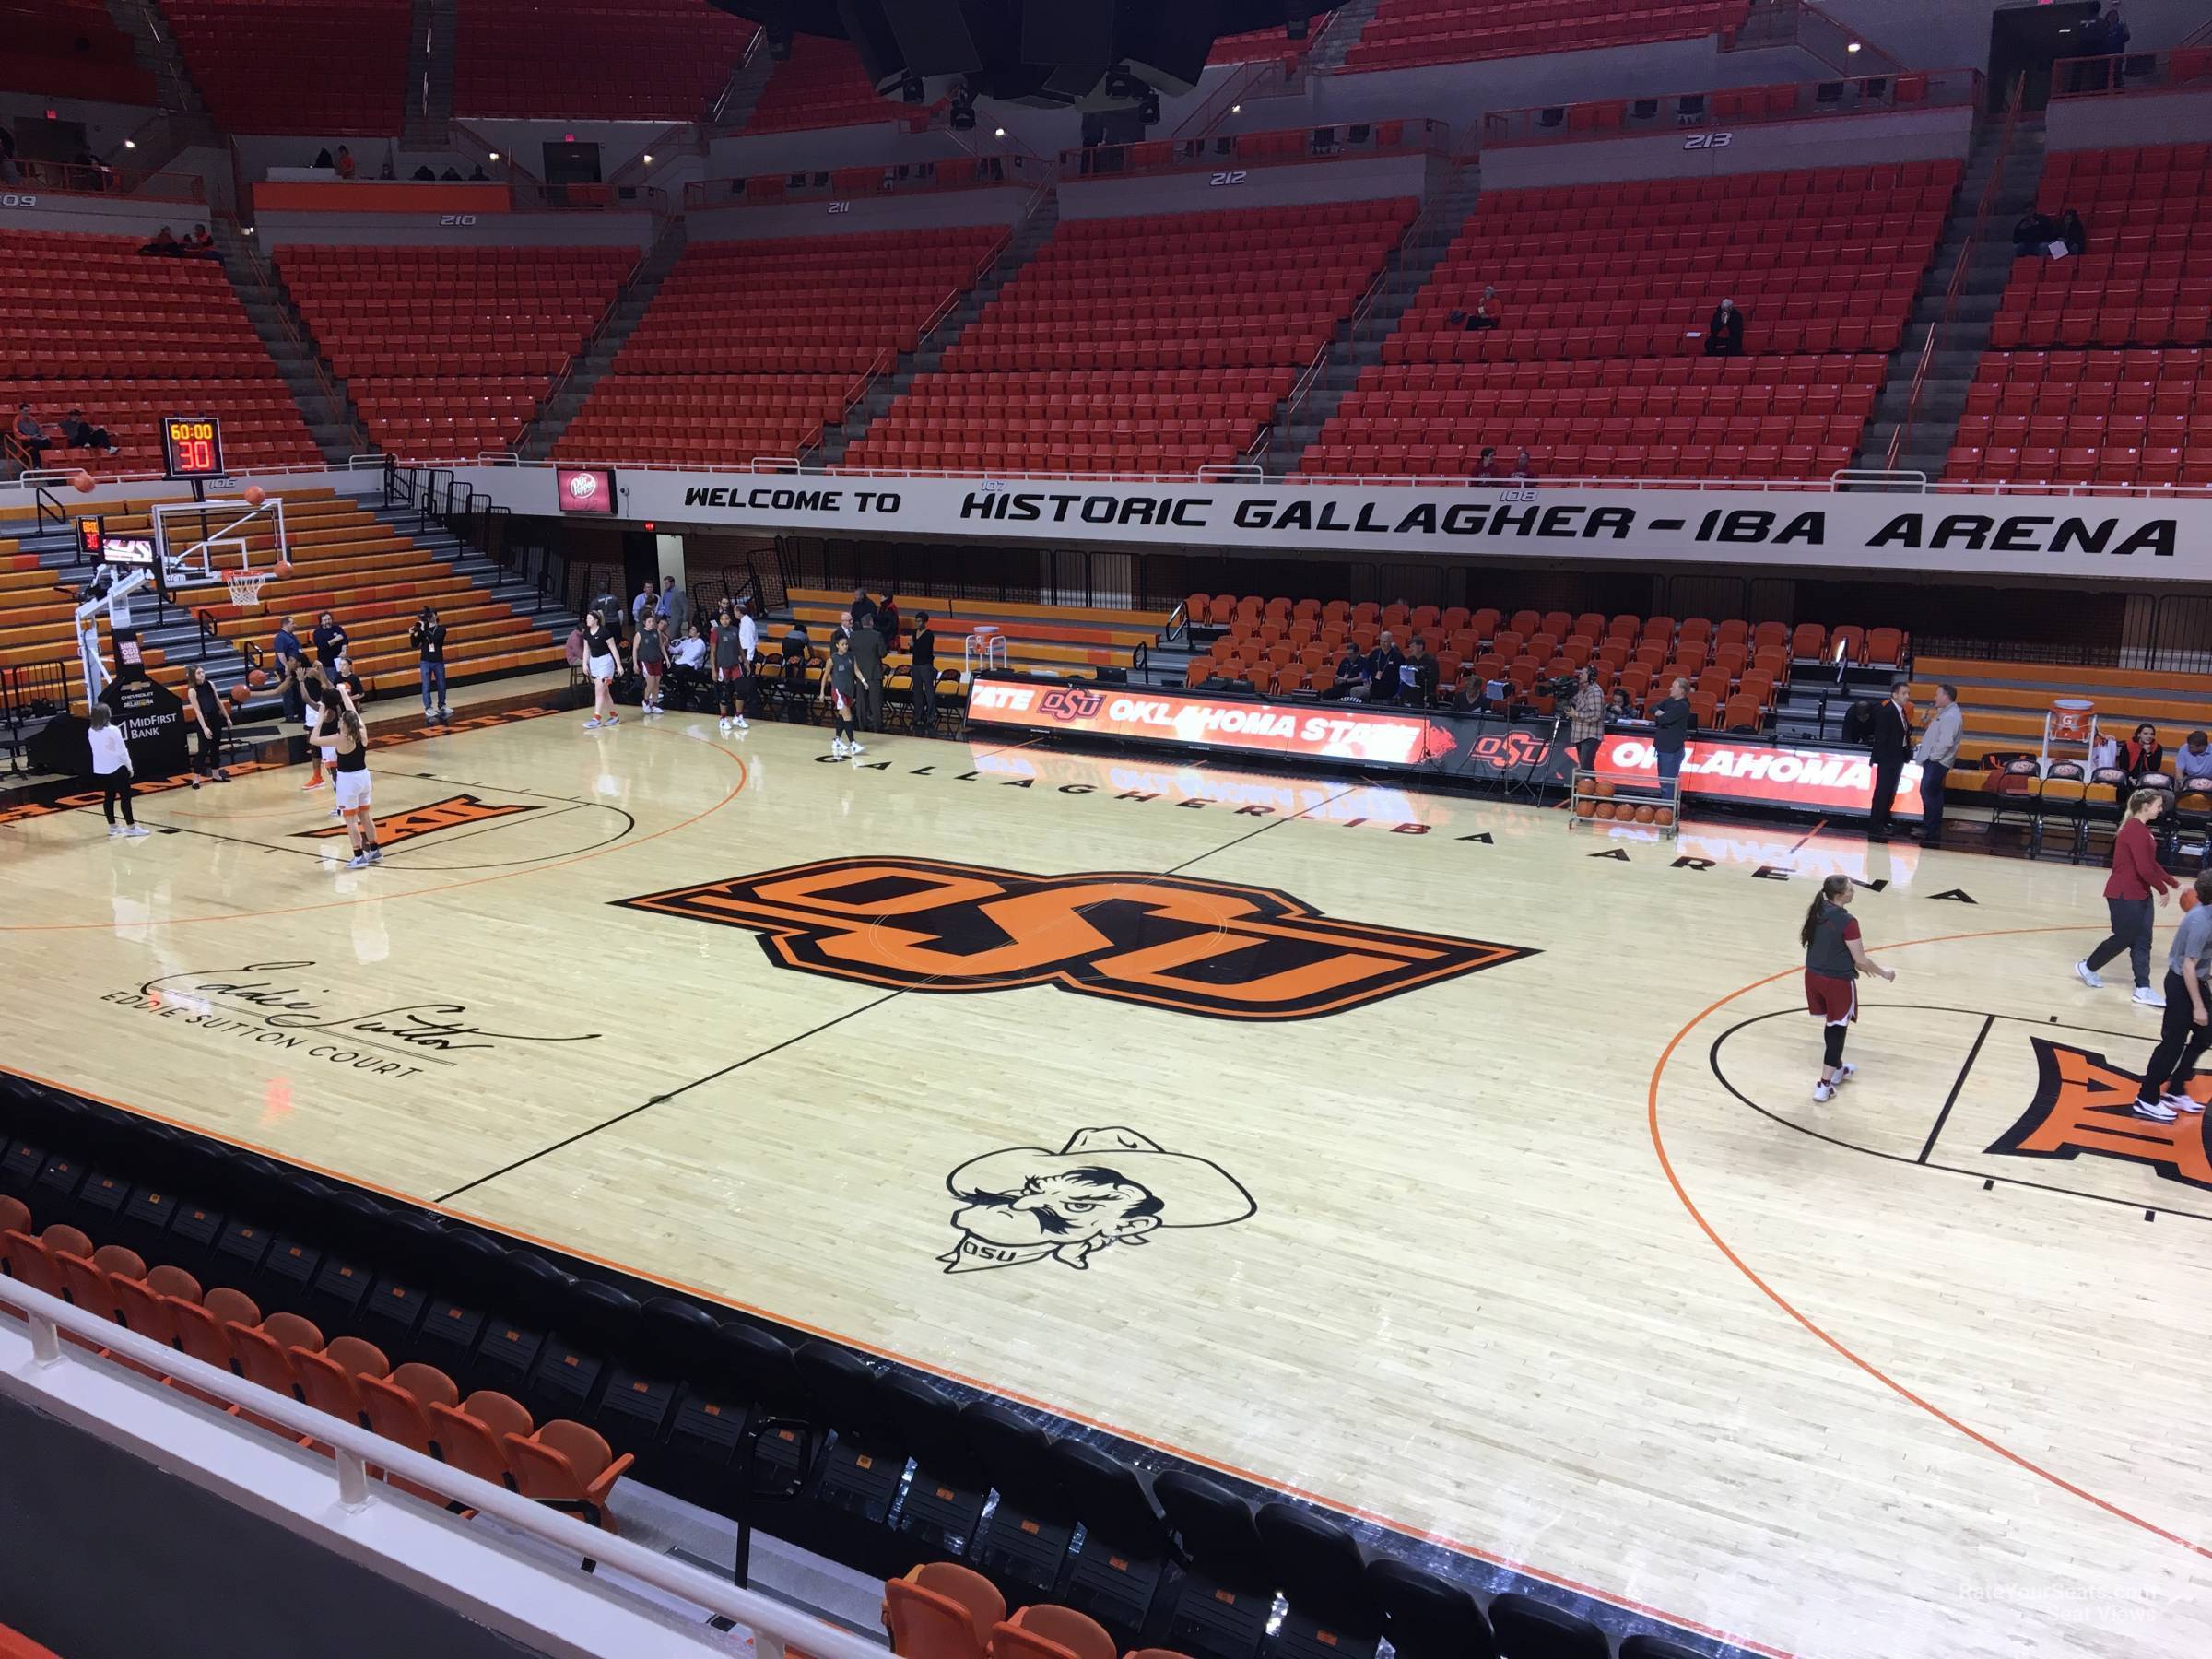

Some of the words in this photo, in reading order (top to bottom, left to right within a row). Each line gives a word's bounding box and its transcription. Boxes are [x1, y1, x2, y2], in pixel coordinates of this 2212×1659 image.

[1683, 132, 1733, 149] 213
[1210, 171, 1247, 186] 212
[0, 194, 37, 208] 09
[827, 200, 850, 214] 211
[440, 213, 477, 227] 210
[171, 424, 213, 440] 60:00
[178, 441, 210, 468] 30
[209, 478, 237, 489] 106
[981, 480, 1005, 492] 107
[1499, 489, 1536, 502] 108
[684, 487, 843, 512] WELCOME
[853, 492, 901, 513] TO
[959, 491, 1214, 527] HISTORIC
[1864, 513, 2177, 558] ARENA
[121, 691, 154, 700] CHEVROLET
[1040, 688, 1105, 722] OSU
[1109, 699, 1297, 738] OKLAHOMA
[1300, 717, 1421, 751] STATE
[2061, 714, 2073, 726] G
[131, 727, 160, 740] BANK
[1471, 732, 1551, 769] OSU
[1584, 847, 1979, 905] ARENA
[100, 990, 189, 1018] EDDIE
[184, 1013, 309, 1050] SUTTON
[307, 1045, 424, 1079] COURT
[962, 1240, 1018, 1263] OSU
